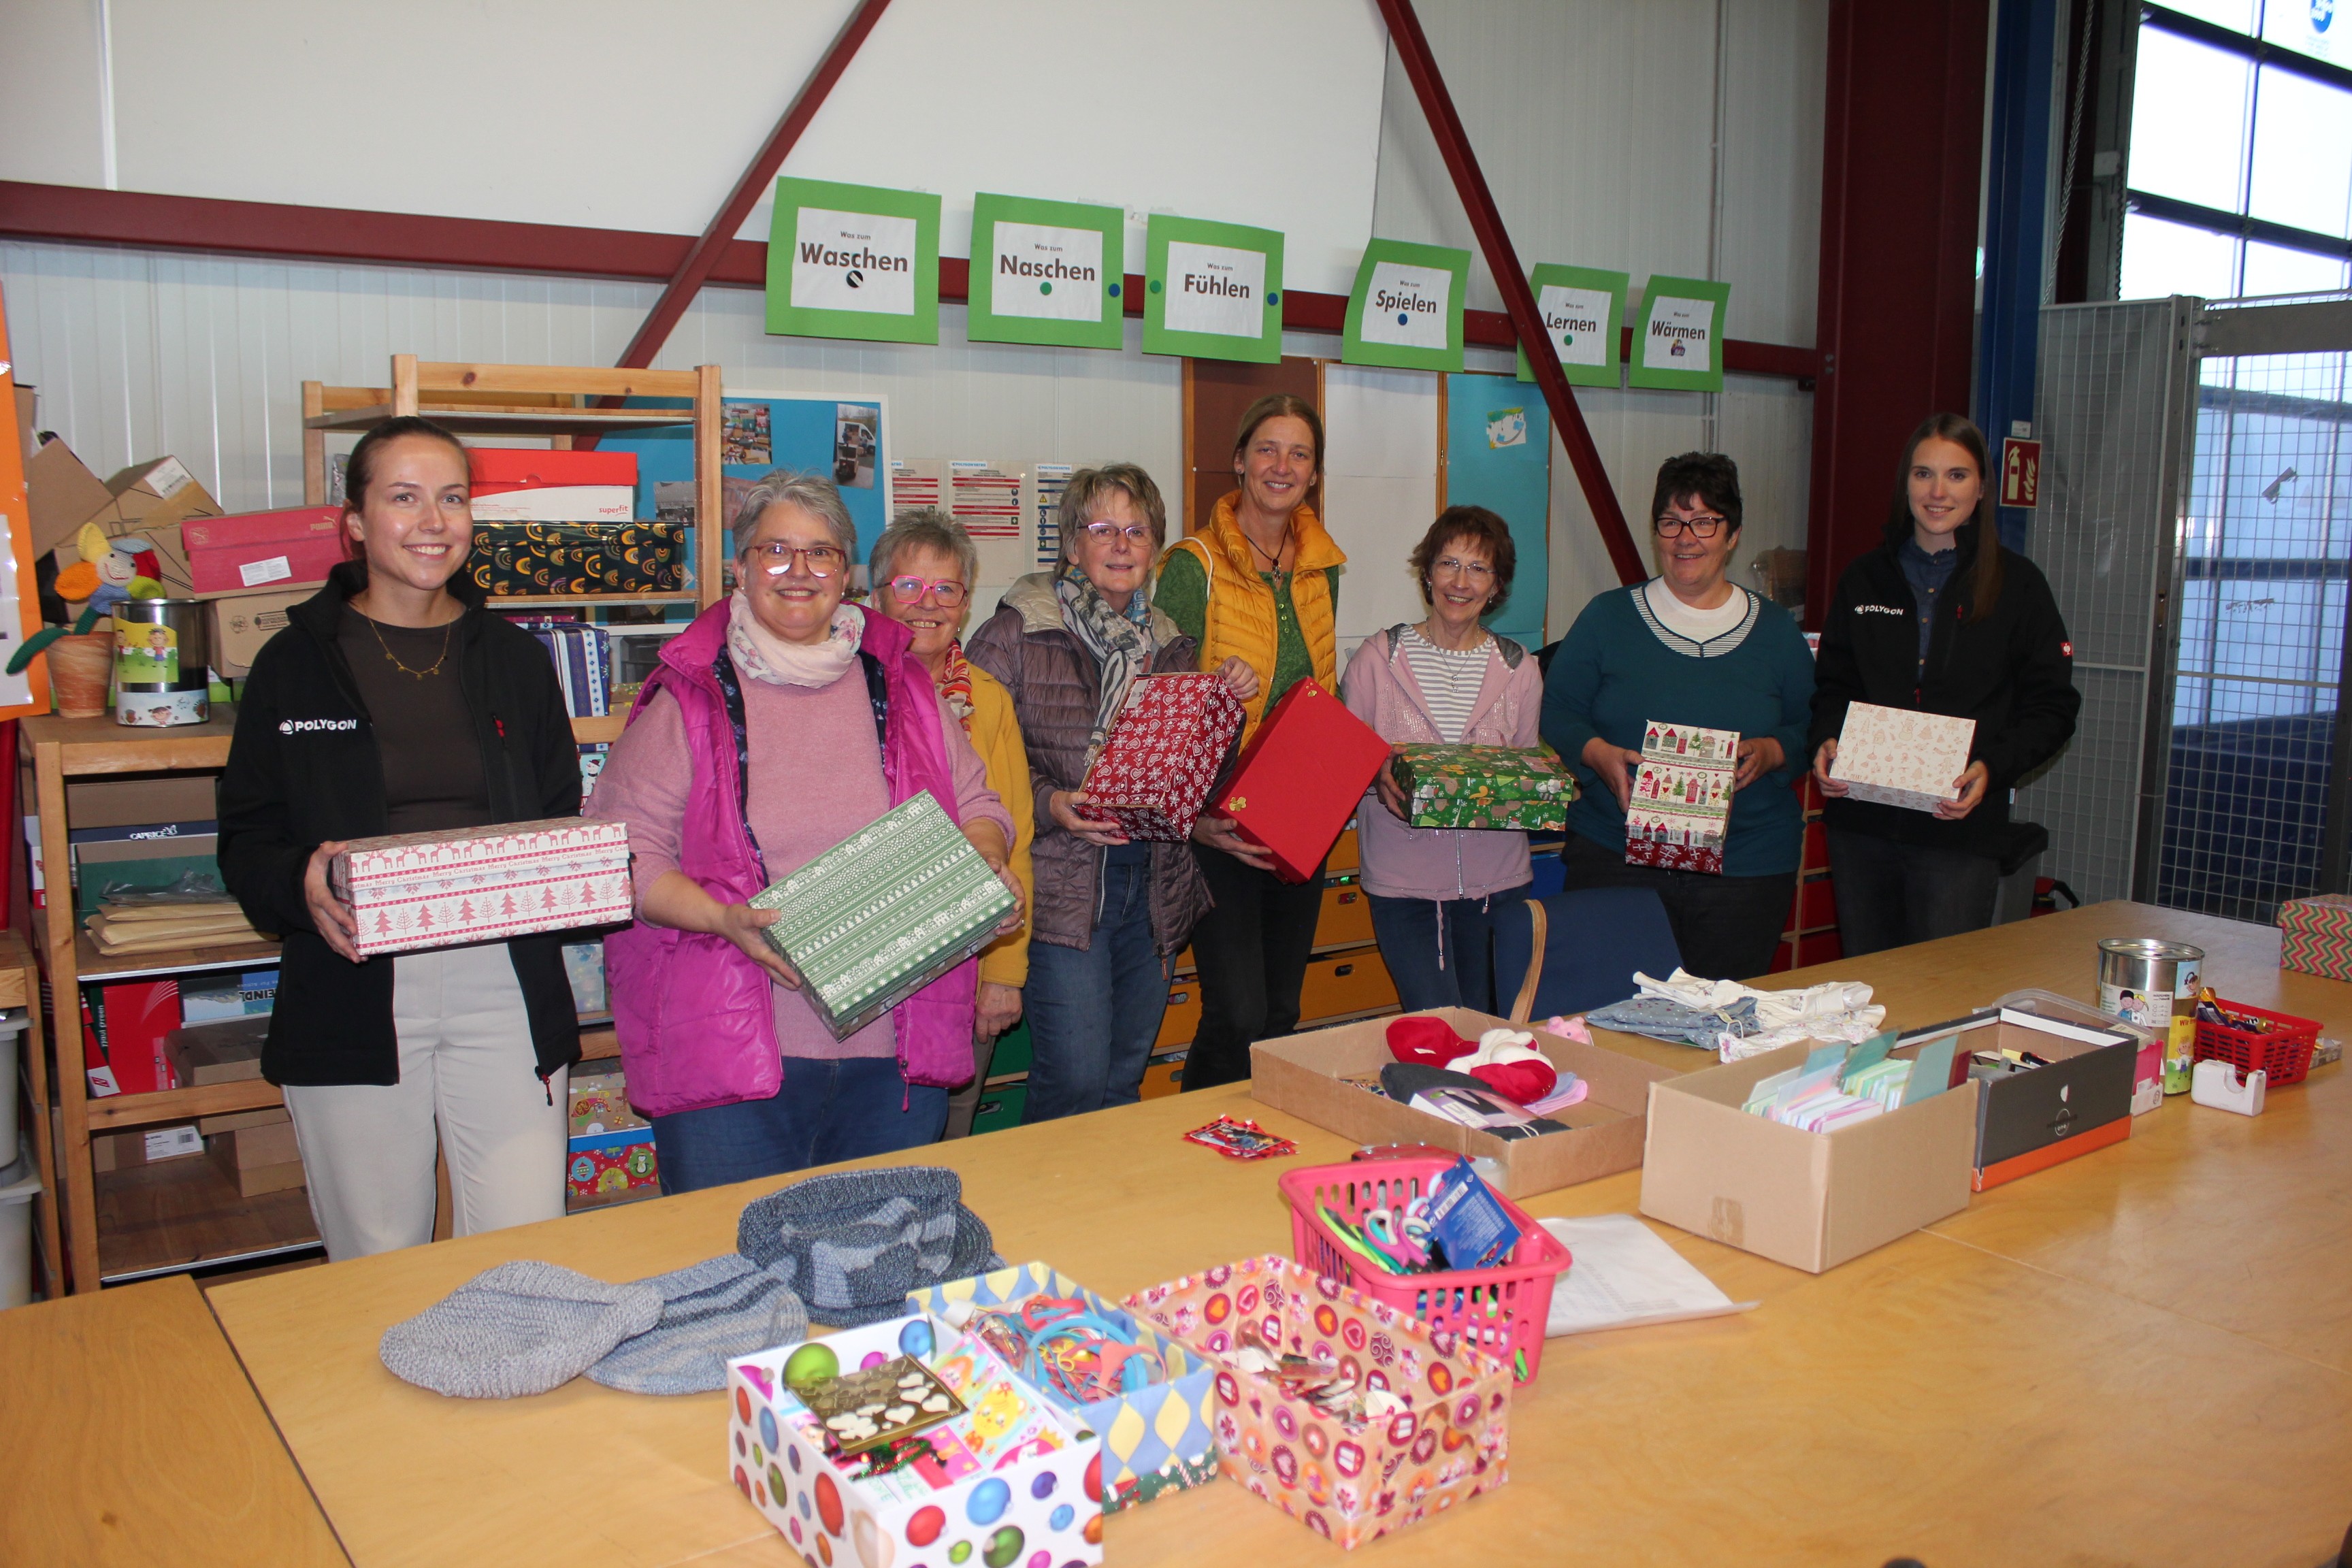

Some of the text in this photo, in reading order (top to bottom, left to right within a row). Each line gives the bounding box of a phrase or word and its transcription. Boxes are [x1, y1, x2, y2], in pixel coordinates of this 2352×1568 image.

[840, 231, 855, 240] Was
[1034, 243, 1049, 251] Was
[800, 242, 908, 272] Waschen
[1000, 255, 1095, 281] Naschen
[1207, 262, 1220, 271] Was
[1183, 274, 1250, 298] Fühlen
[1375, 289, 1437, 313] Spielen
[1546, 312, 1597, 333] Lernen
[1652, 320, 1705, 340] Wärmen
[598, 505, 629, 514] superfit
[1865, 605, 1904, 616] POLYGON
[295, 719, 357, 732] POLYGON
[130, 830, 167, 840] CAPRICE
[397, 875, 429, 883] Christmas
[454, 866, 485, 875] Christmas
[508, 858, 539, 867] Christmas
[541, 855, 560, 863] Merry
[561, 851, 592, 860] Christmas
